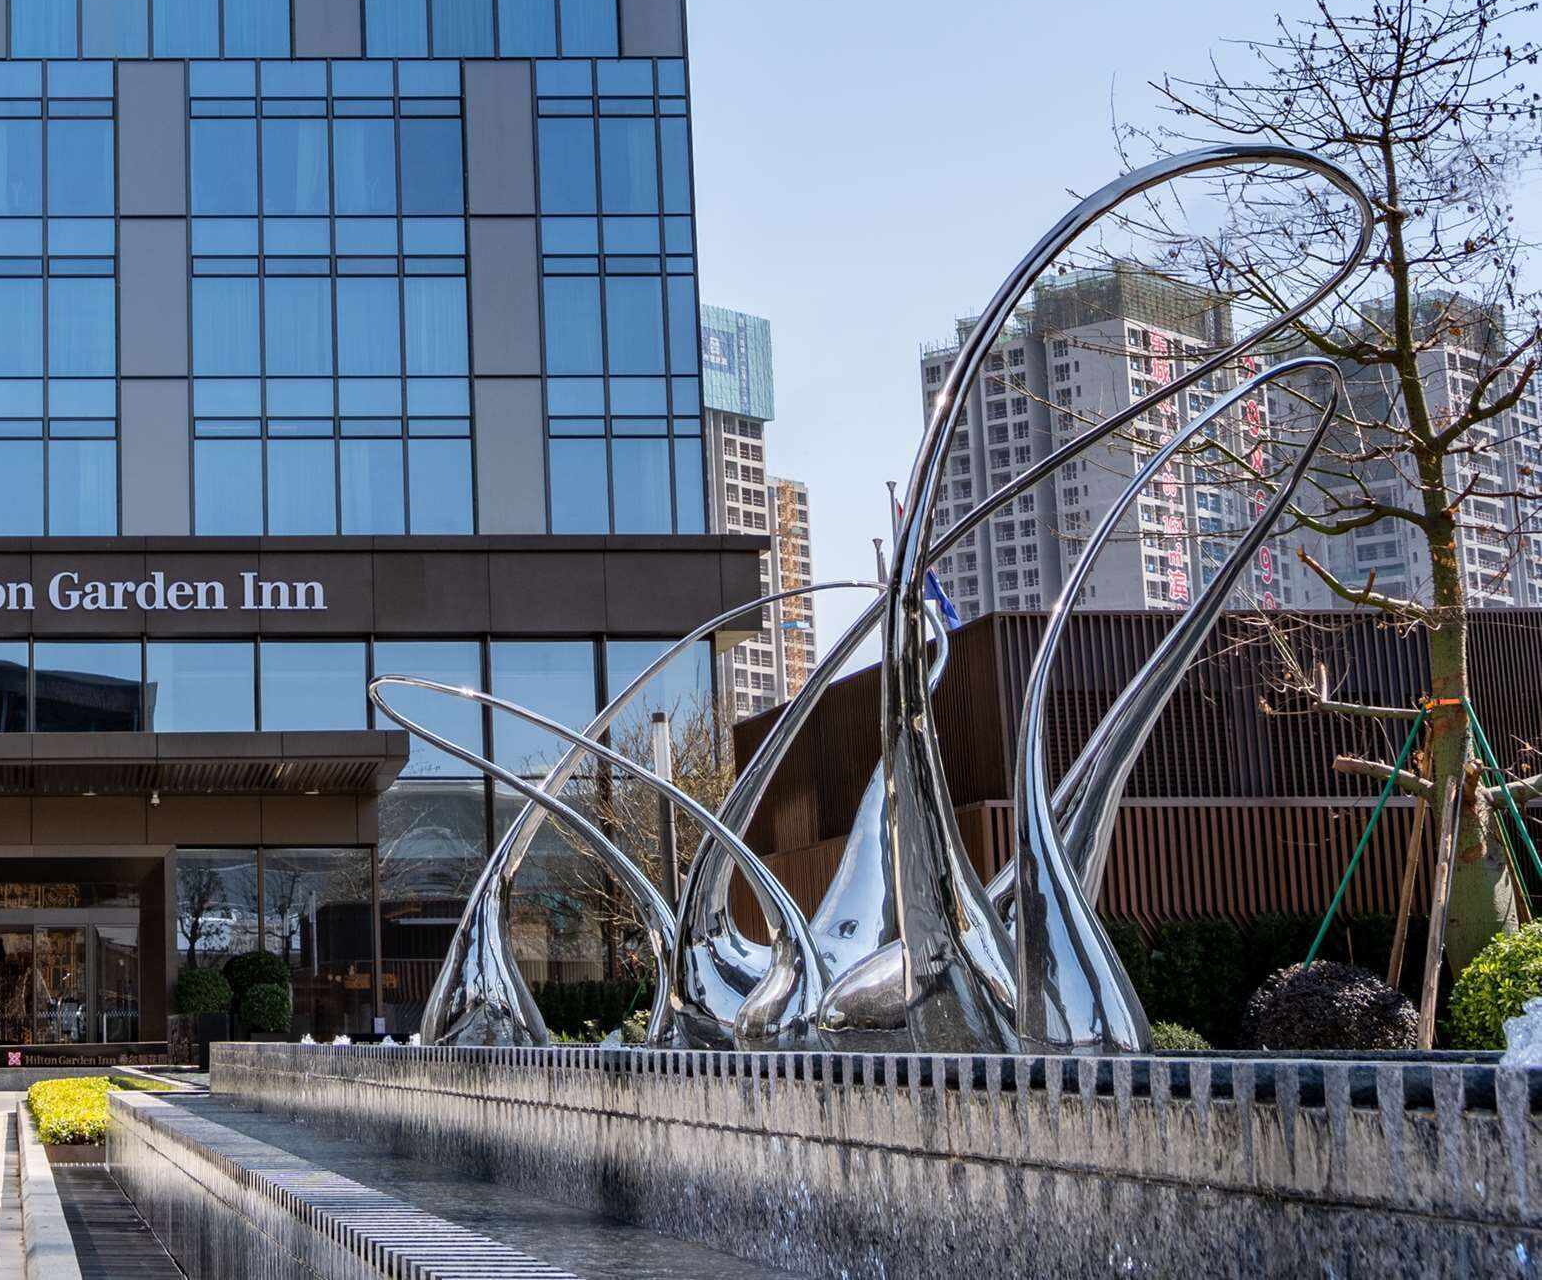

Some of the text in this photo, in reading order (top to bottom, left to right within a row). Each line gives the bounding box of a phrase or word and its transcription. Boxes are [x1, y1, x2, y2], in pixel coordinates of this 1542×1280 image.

[48, 571, 228, 611] Garden
[239, 572, 328, 610] Inn
[25, 1054, 58, 1066] Hilton
[58, 1054, 96, 1066] Garden
[98, 1055, 117, 1066] Inn
